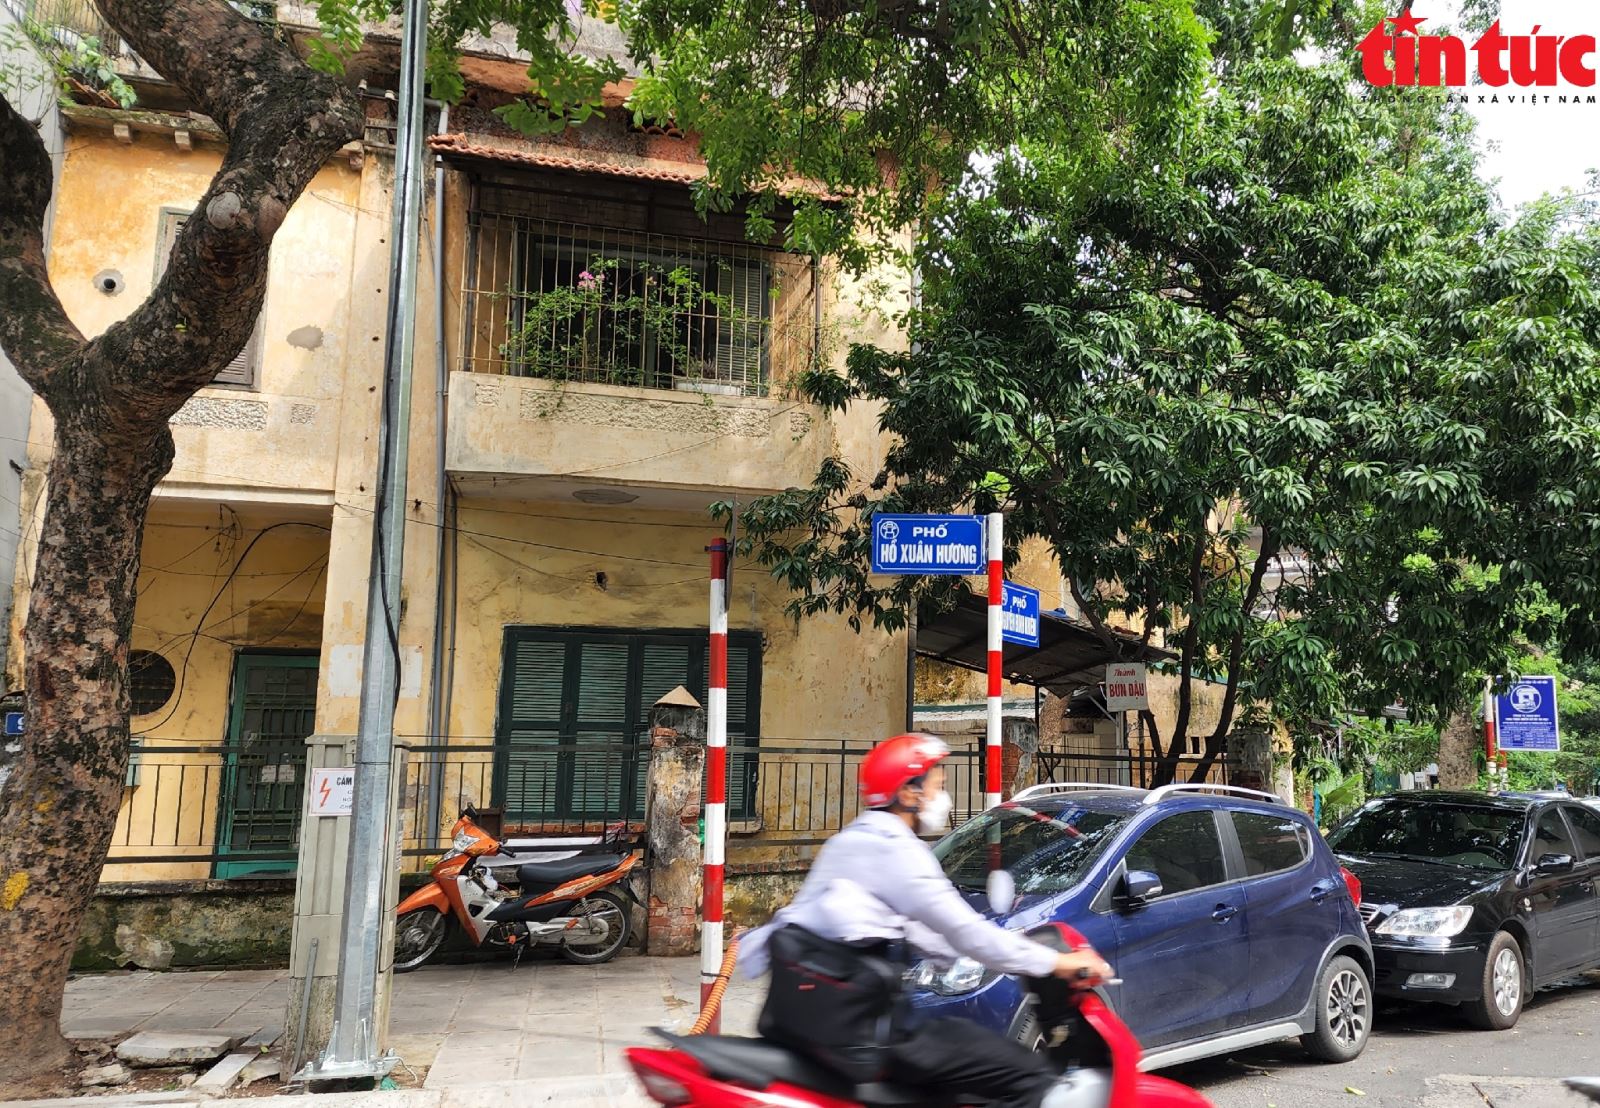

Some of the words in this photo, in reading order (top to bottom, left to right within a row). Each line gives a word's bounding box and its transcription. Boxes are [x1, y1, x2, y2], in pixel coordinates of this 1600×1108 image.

[912, 522, 949, 539] PHỐ
[900, 540, 933, 564] XUÂN
[936, 542, 977, 565] HƯƠNG
[1012, 594, 1027, 609] PHỐ
[1109, 680, 1127, 698] BÚN
